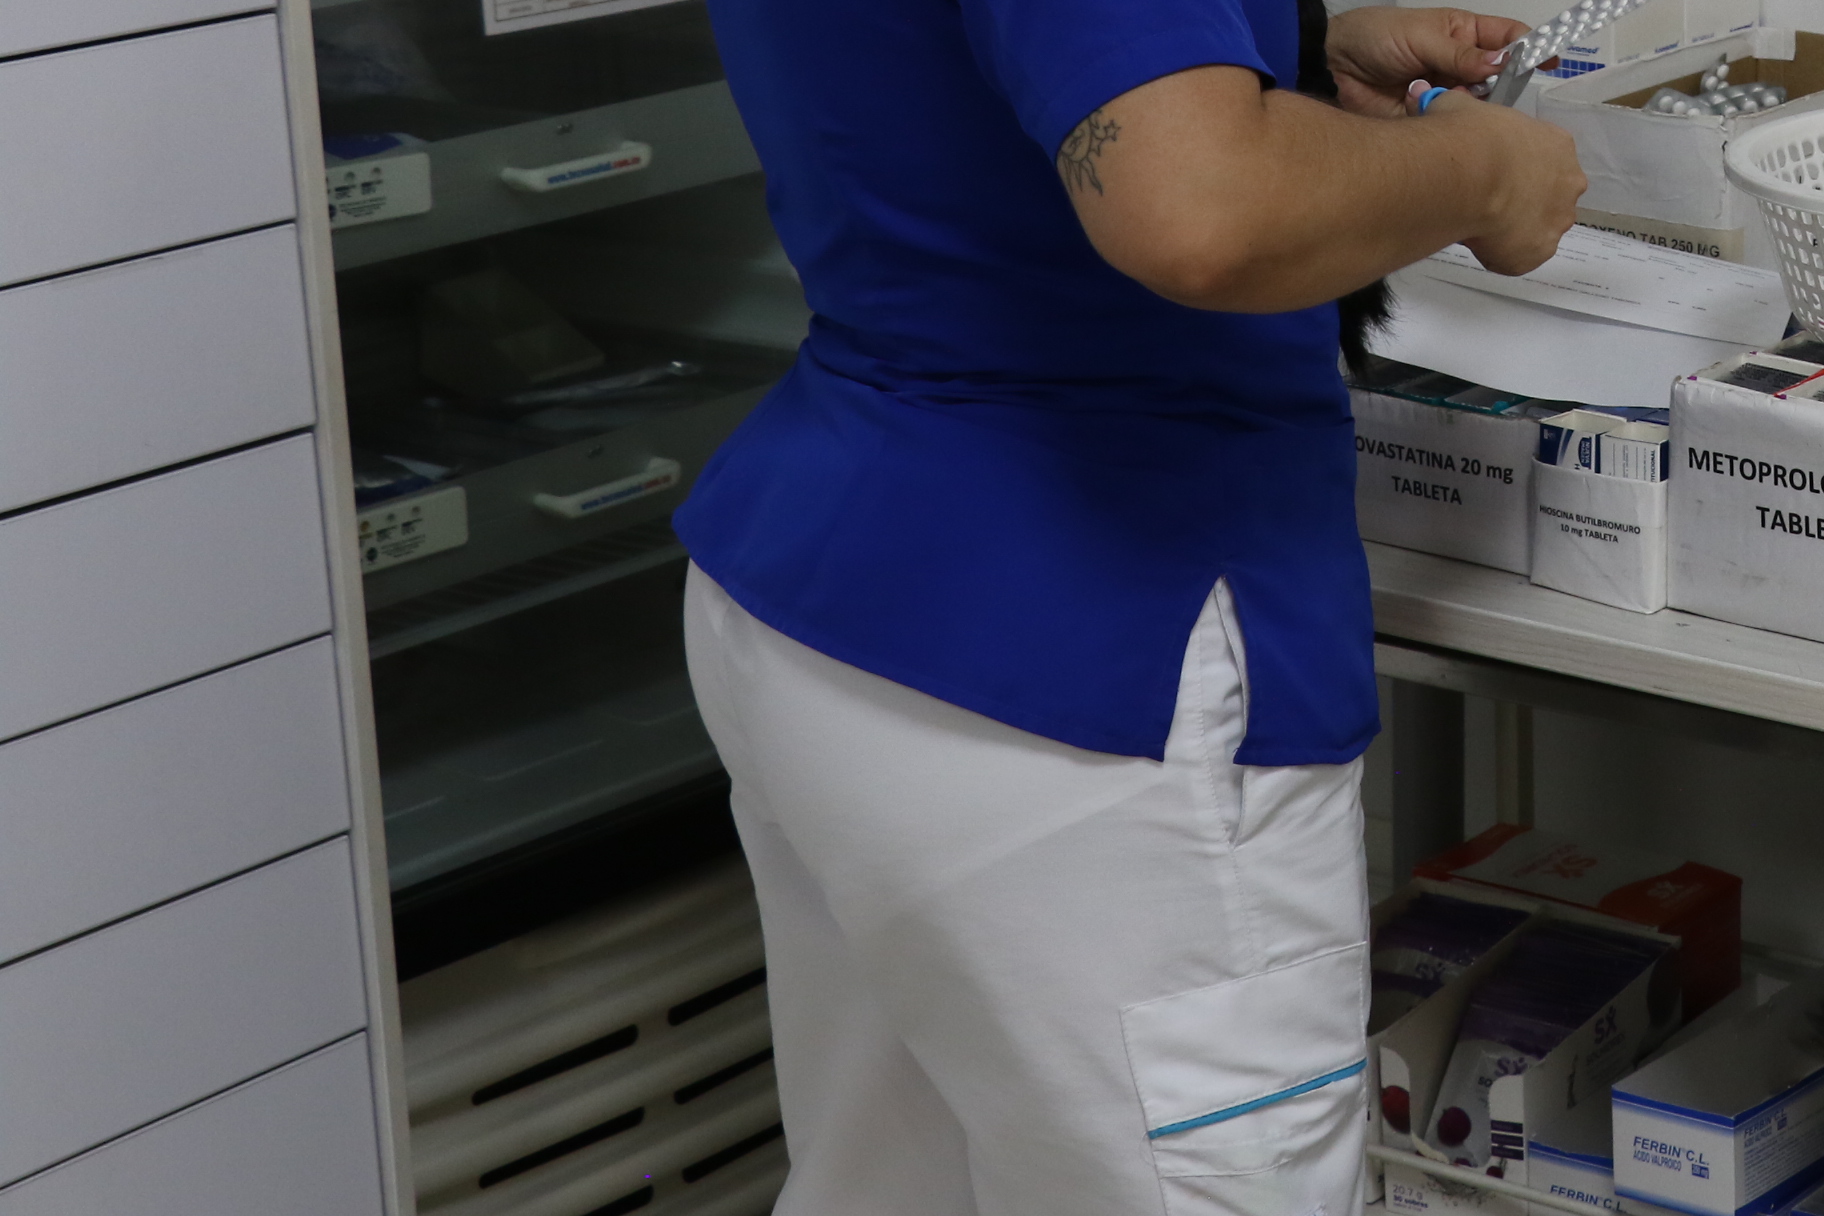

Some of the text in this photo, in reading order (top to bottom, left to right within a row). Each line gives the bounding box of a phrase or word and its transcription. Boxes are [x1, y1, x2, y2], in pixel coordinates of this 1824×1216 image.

[1671, 238, 1694, 254] 250
[1355, 435, 1514, 485] OVASTATINA 20 mg
[1391, 475, 1463, 506] TABLETA
[1539, 504, 1641, 535] HIOSCINA BUTILBROMURO
[1560, 523, 1619, 544] 10 mg TABLETA
[1633, 1136, 1682, 1159] FERBIN
[1651, 1153, 1682, 1173] VALPROICO
